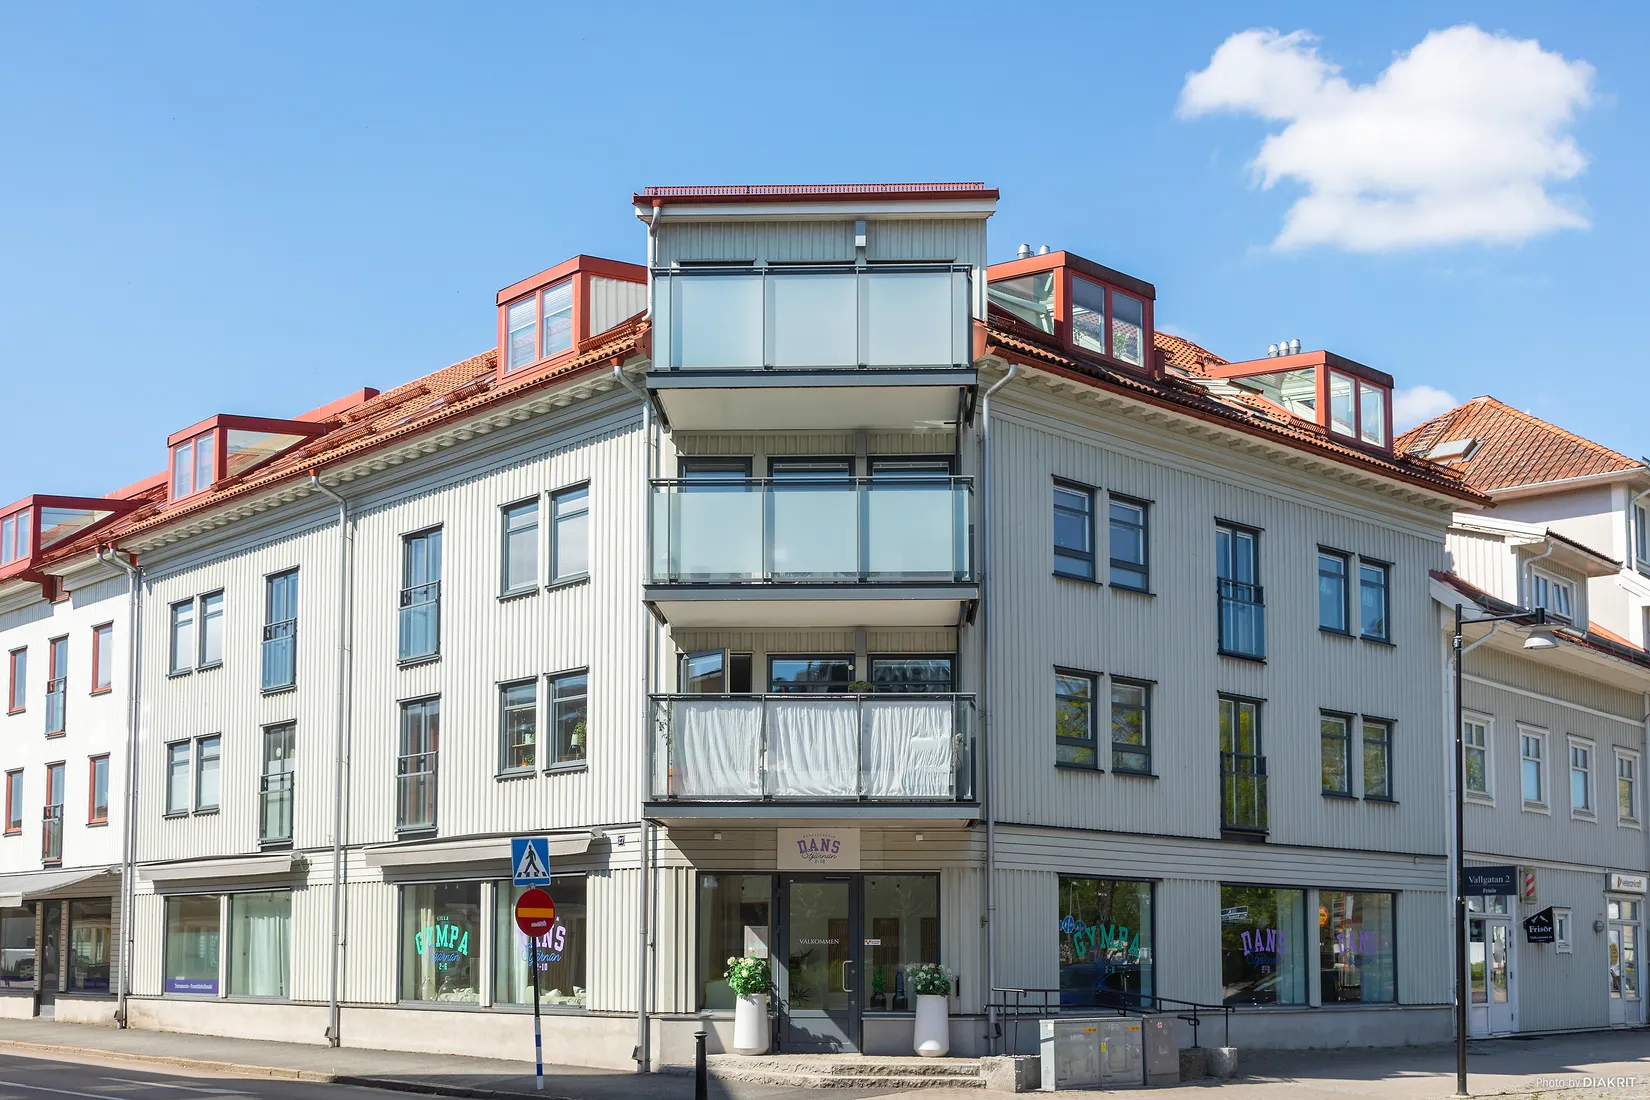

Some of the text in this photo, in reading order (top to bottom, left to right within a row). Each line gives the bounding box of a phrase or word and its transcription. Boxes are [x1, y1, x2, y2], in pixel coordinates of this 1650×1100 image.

[797, 838, 841, 854] DANS
[1468, 875, 1511, 886] Vallgatan 2
[1529, 925, 1553, 933] Frisör
[415, 923, 468, 956] GYMPA
[1073, 924, 1139, 958] GYMPA
[1241, 928, 1287, 956] DANS
[1336, 929, 1378, 957] DANS
[438, 962, 448, 971] 2-6
[1104, 965, 1116, 974] 2-6
